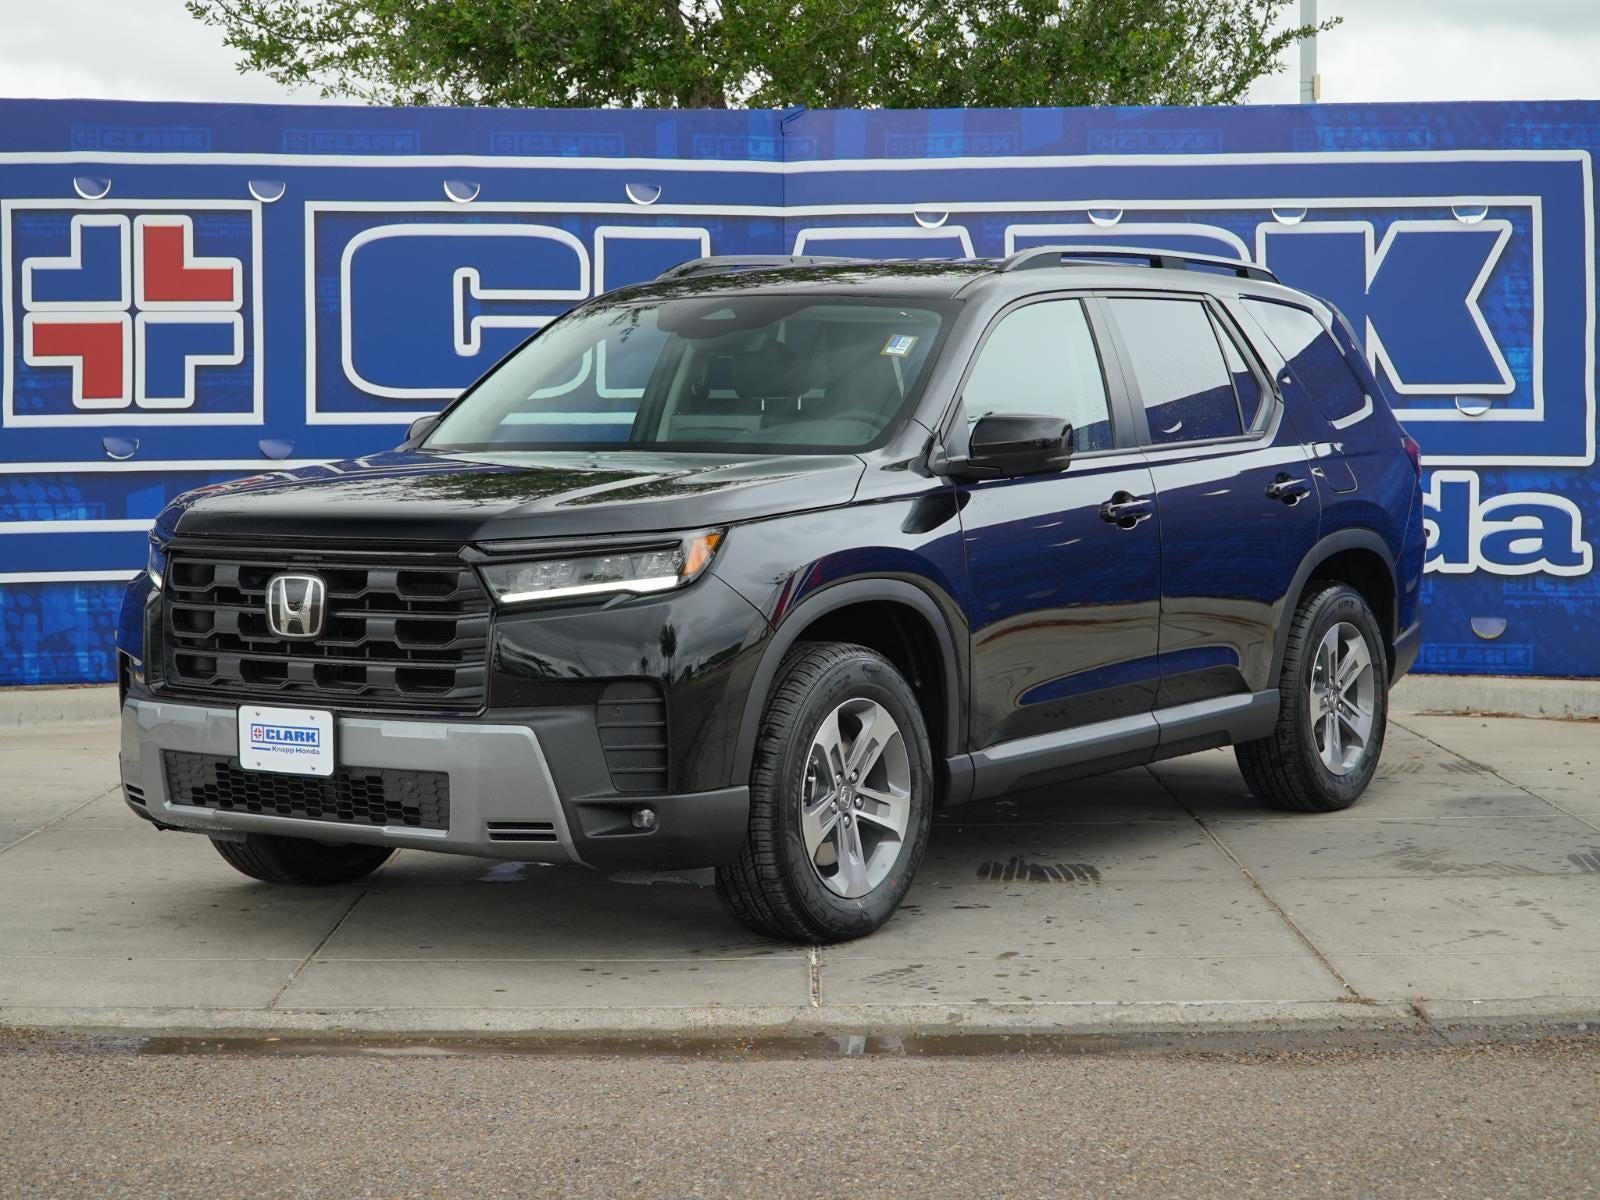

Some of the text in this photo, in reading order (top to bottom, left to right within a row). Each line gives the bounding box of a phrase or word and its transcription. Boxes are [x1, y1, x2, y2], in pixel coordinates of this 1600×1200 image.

[315, 134, 413, 150] CLARK
[1426, 647, 1525, 664] CLARK
[266, 729, 316, 742] CLARK
[296, 747, 320, 755] Honda
